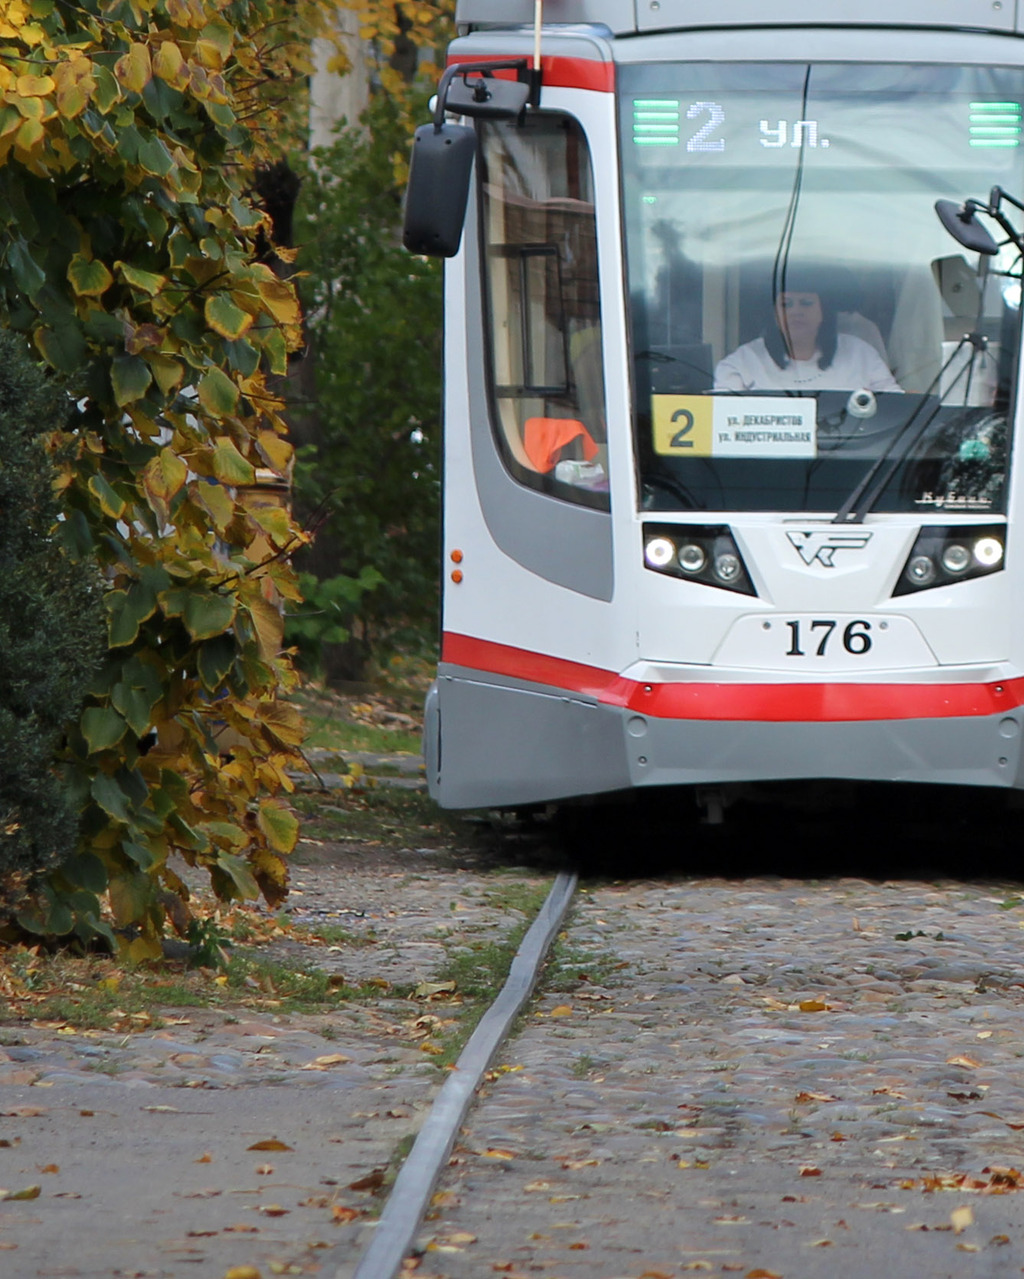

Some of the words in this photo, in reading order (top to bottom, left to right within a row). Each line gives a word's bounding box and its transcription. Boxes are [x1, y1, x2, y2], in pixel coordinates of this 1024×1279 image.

[685, 101, 726, 153] 2
[759, 119, 830, 148] ул.
[669, 408, 695, 448] 2
[727, 416, 740, 426] ул.
[743, 415, 803, 426] ДЕКАБРИСТОВ
[718, 432, 731, 443] ул.
[734, 431, 811, 443] ИНДУСТРИАЛЬНАЯ
[785, 620, 873, 656] 176
